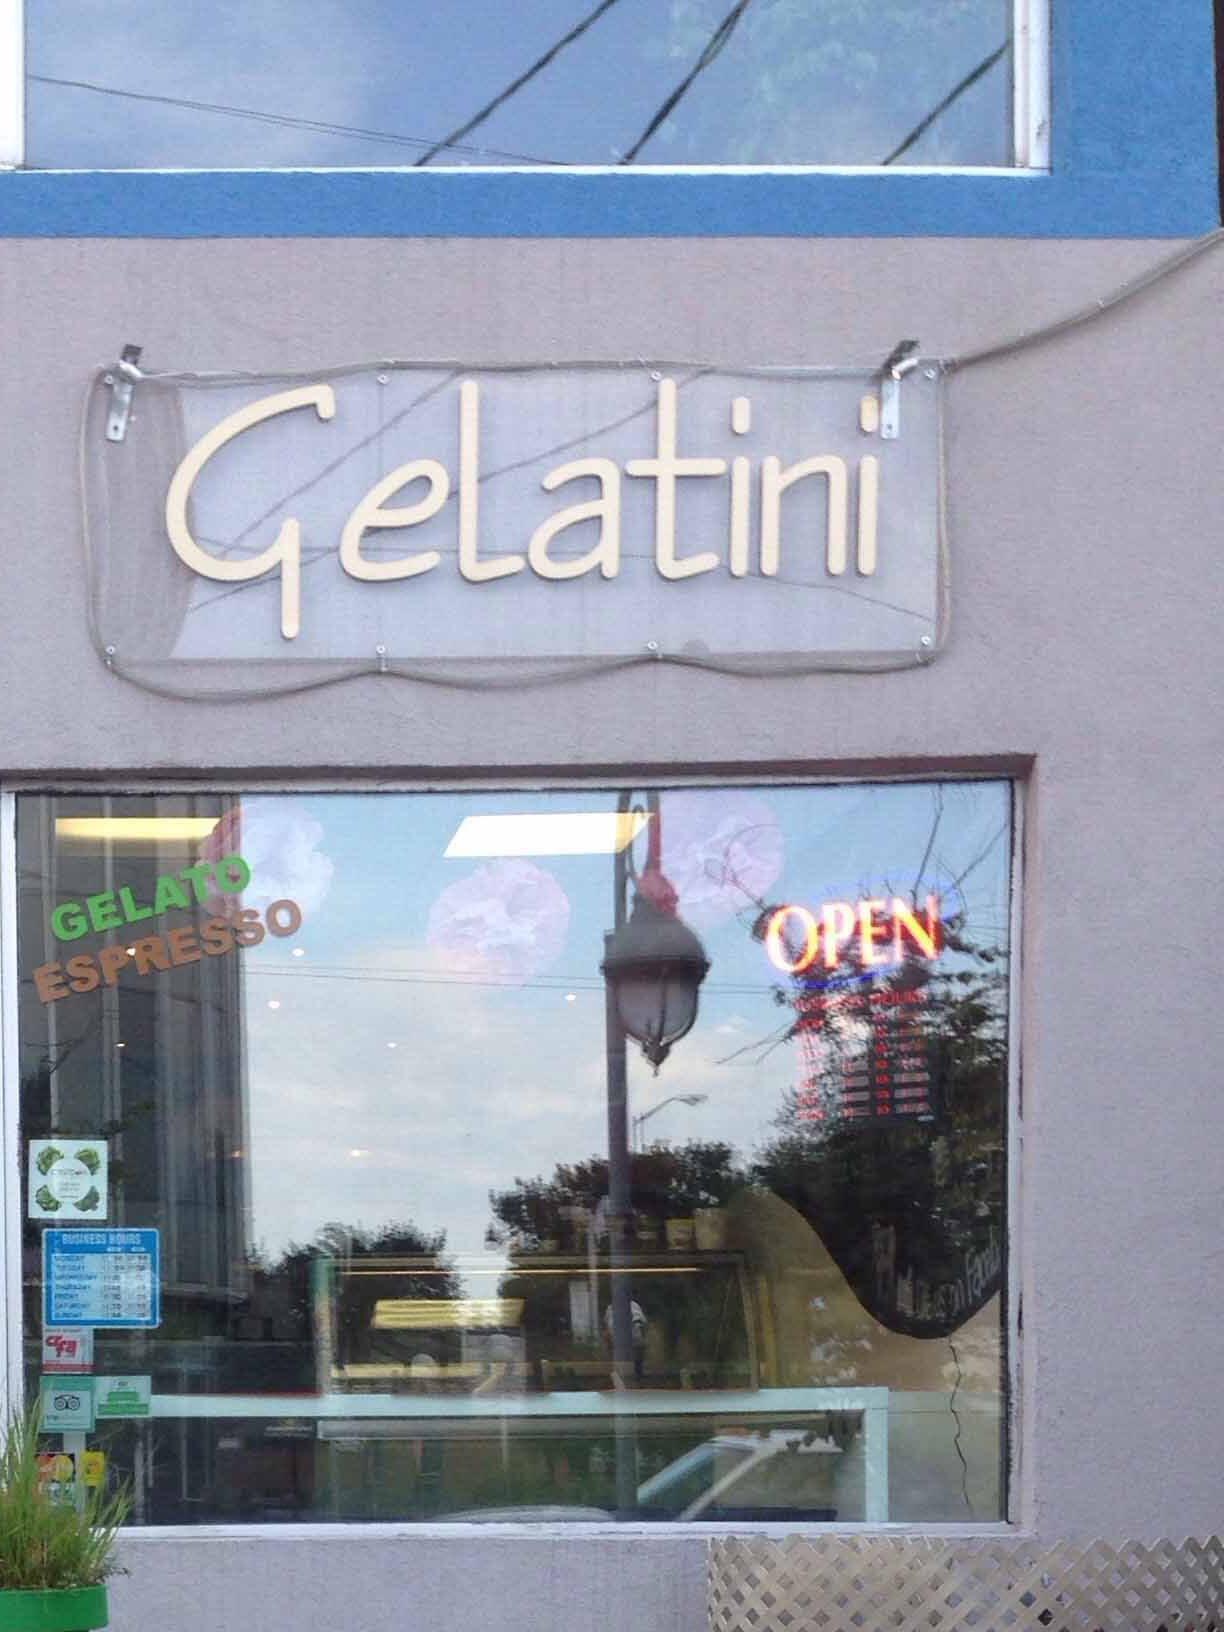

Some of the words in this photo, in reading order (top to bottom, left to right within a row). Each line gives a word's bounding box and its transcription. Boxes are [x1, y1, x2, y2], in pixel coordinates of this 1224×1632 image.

[166, 379, 880, 640] Gelatini
[51, 856, 251, 942] GELATO
[766, 894, 943, 974] OPEN
[33, 898, 302, 1003] ESPRESSO
